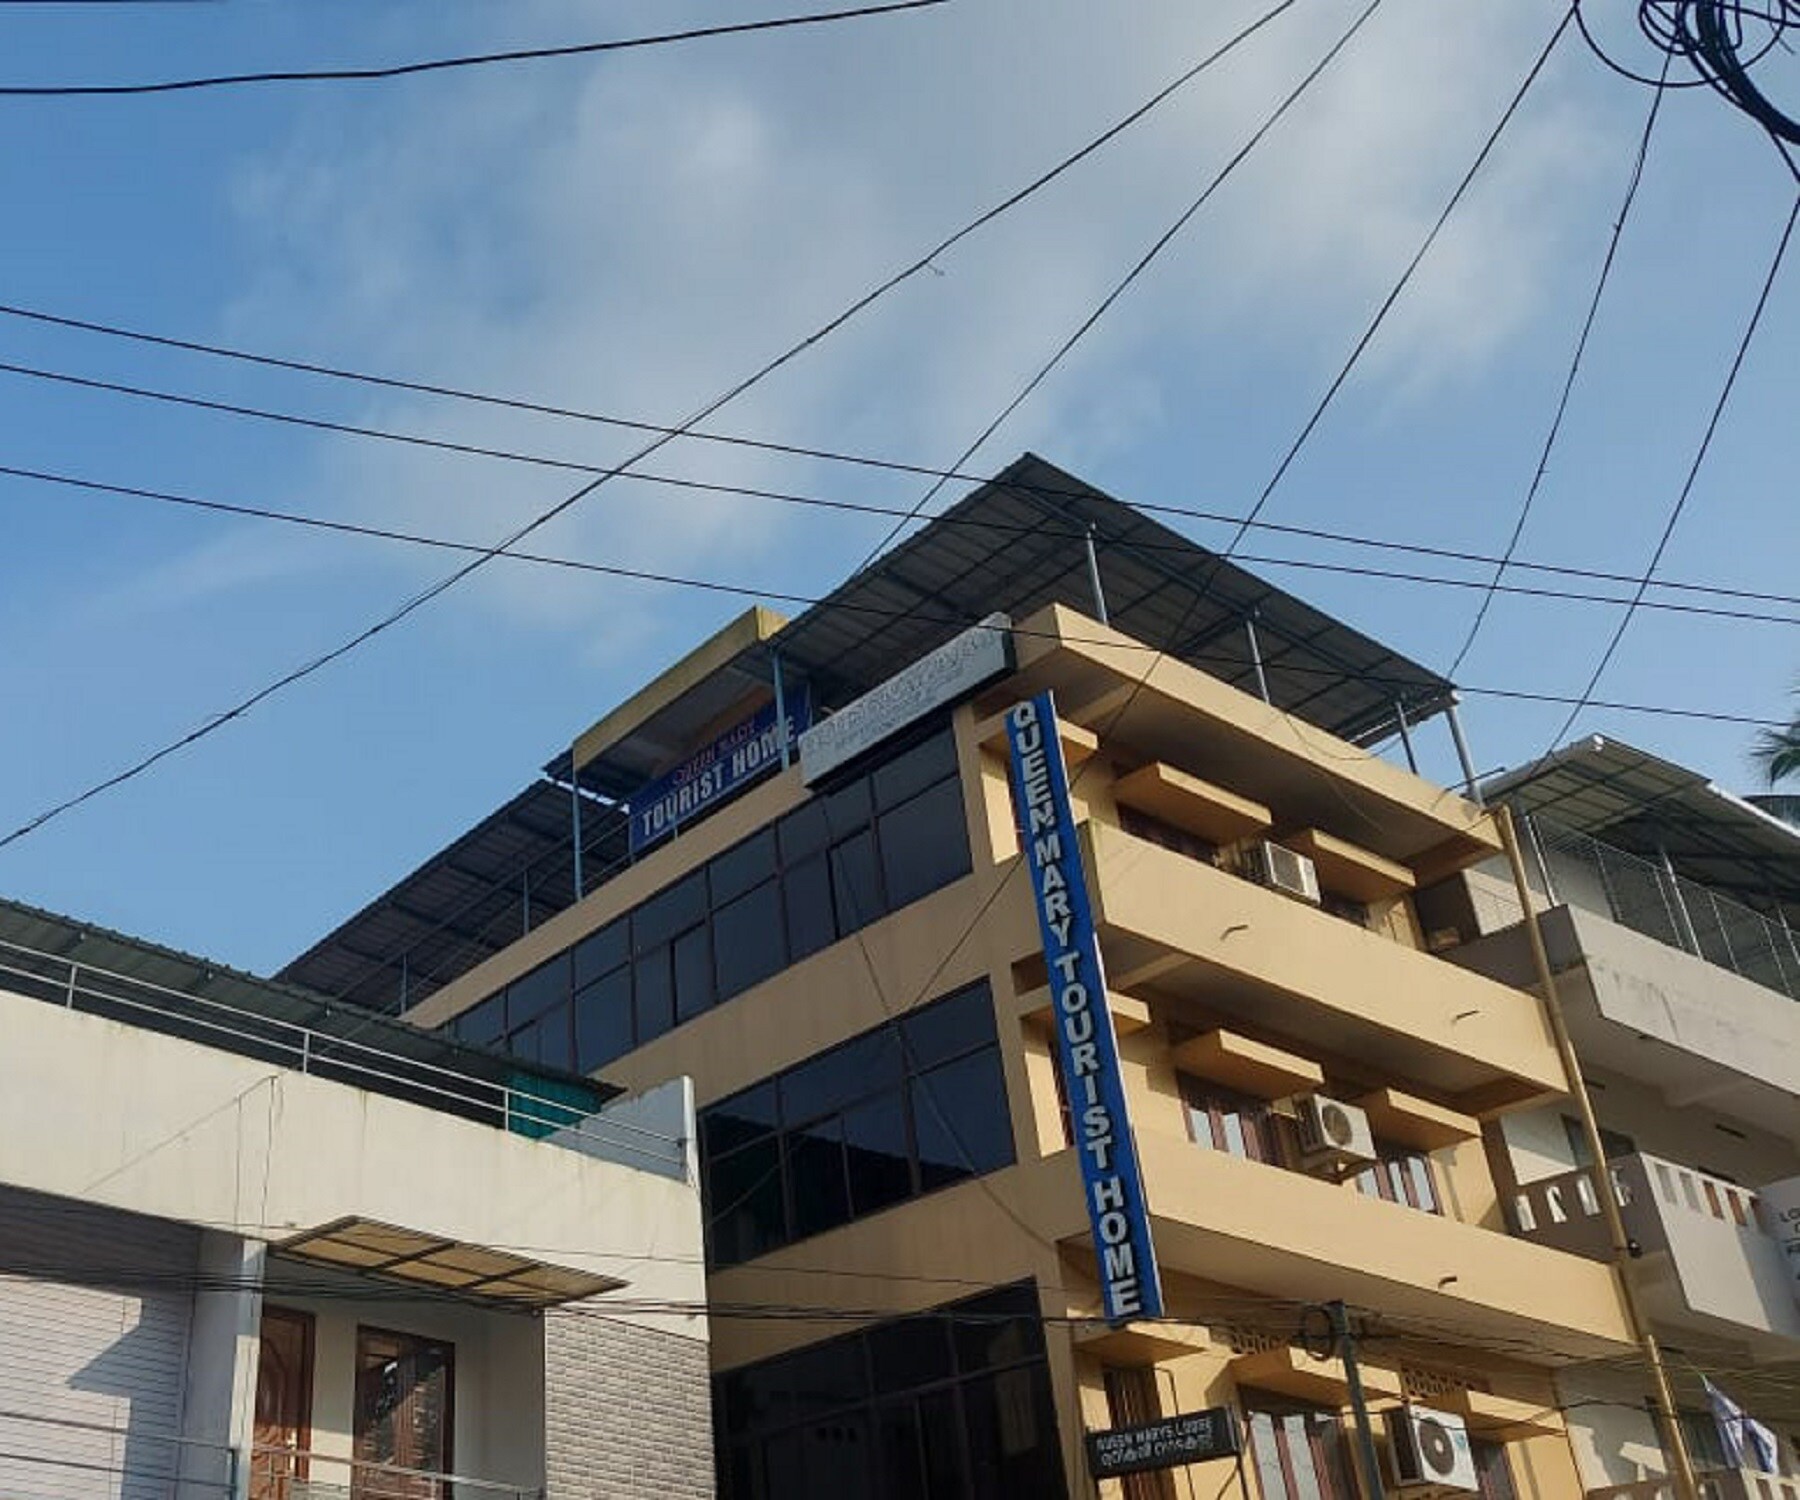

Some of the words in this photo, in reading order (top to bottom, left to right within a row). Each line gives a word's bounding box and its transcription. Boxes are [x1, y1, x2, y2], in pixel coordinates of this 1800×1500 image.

[642, 763, 727, 836] TOURIST
[732, 715, 796, 778] HOME
[1013, 701, 1056, 834] QUEEN
[1034, 834, 1072, 947] MARY
[1054, 952, 1112, 1169] TOURIST
[1093, 1176, 1141, 1317] HOME
